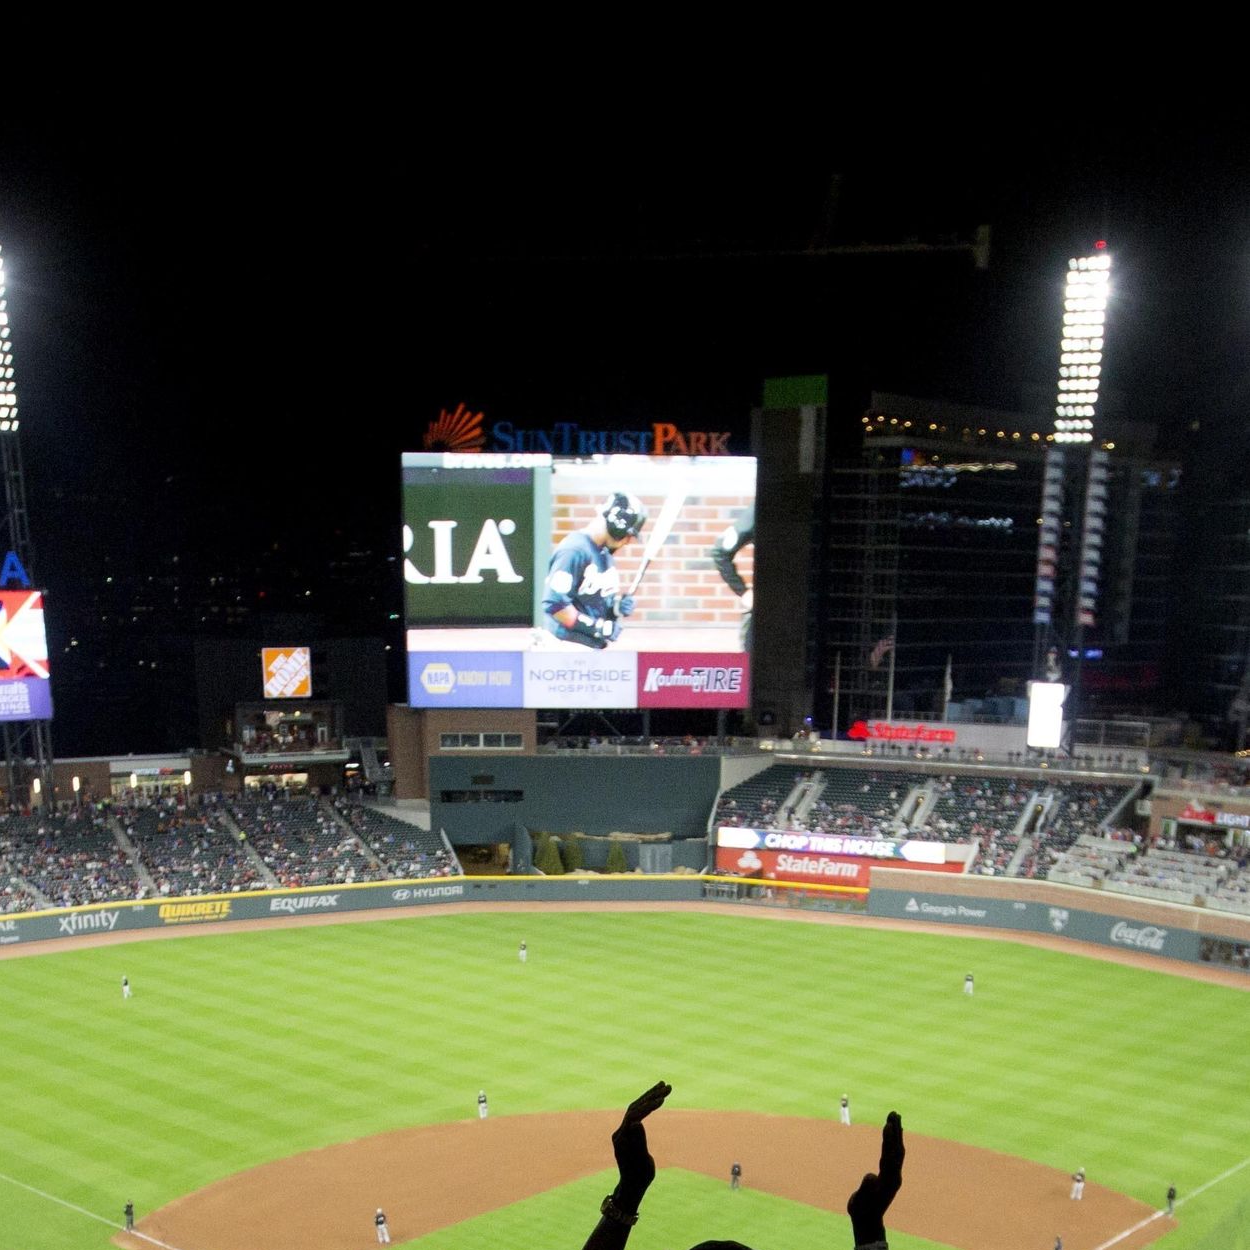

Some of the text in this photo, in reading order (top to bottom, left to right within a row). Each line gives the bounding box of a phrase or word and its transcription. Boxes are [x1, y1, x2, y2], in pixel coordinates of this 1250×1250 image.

[427, 671, 451, 685] NAPA
[529, 670, 632, 682] NORTHSIDE
[643, 667, 743, 693] Kauffman TIRE
[548, 685, 612, 693] HOSPITAL
[765, 833, 896, 857] CHOP THIS HOUSE
[775, 854, 859, 878] StateFarm
[413, 886, 463, 898] HYUNDAI
[159, 901, 231, 918] QUIKRETE
[270, 895, 341, 912] EQUIFAX
[921, 902, 987, 918] Georgia Power
[58, 909, 120, 935] xfinity
[1110, 921, 1168, 949] Coca-Cola
